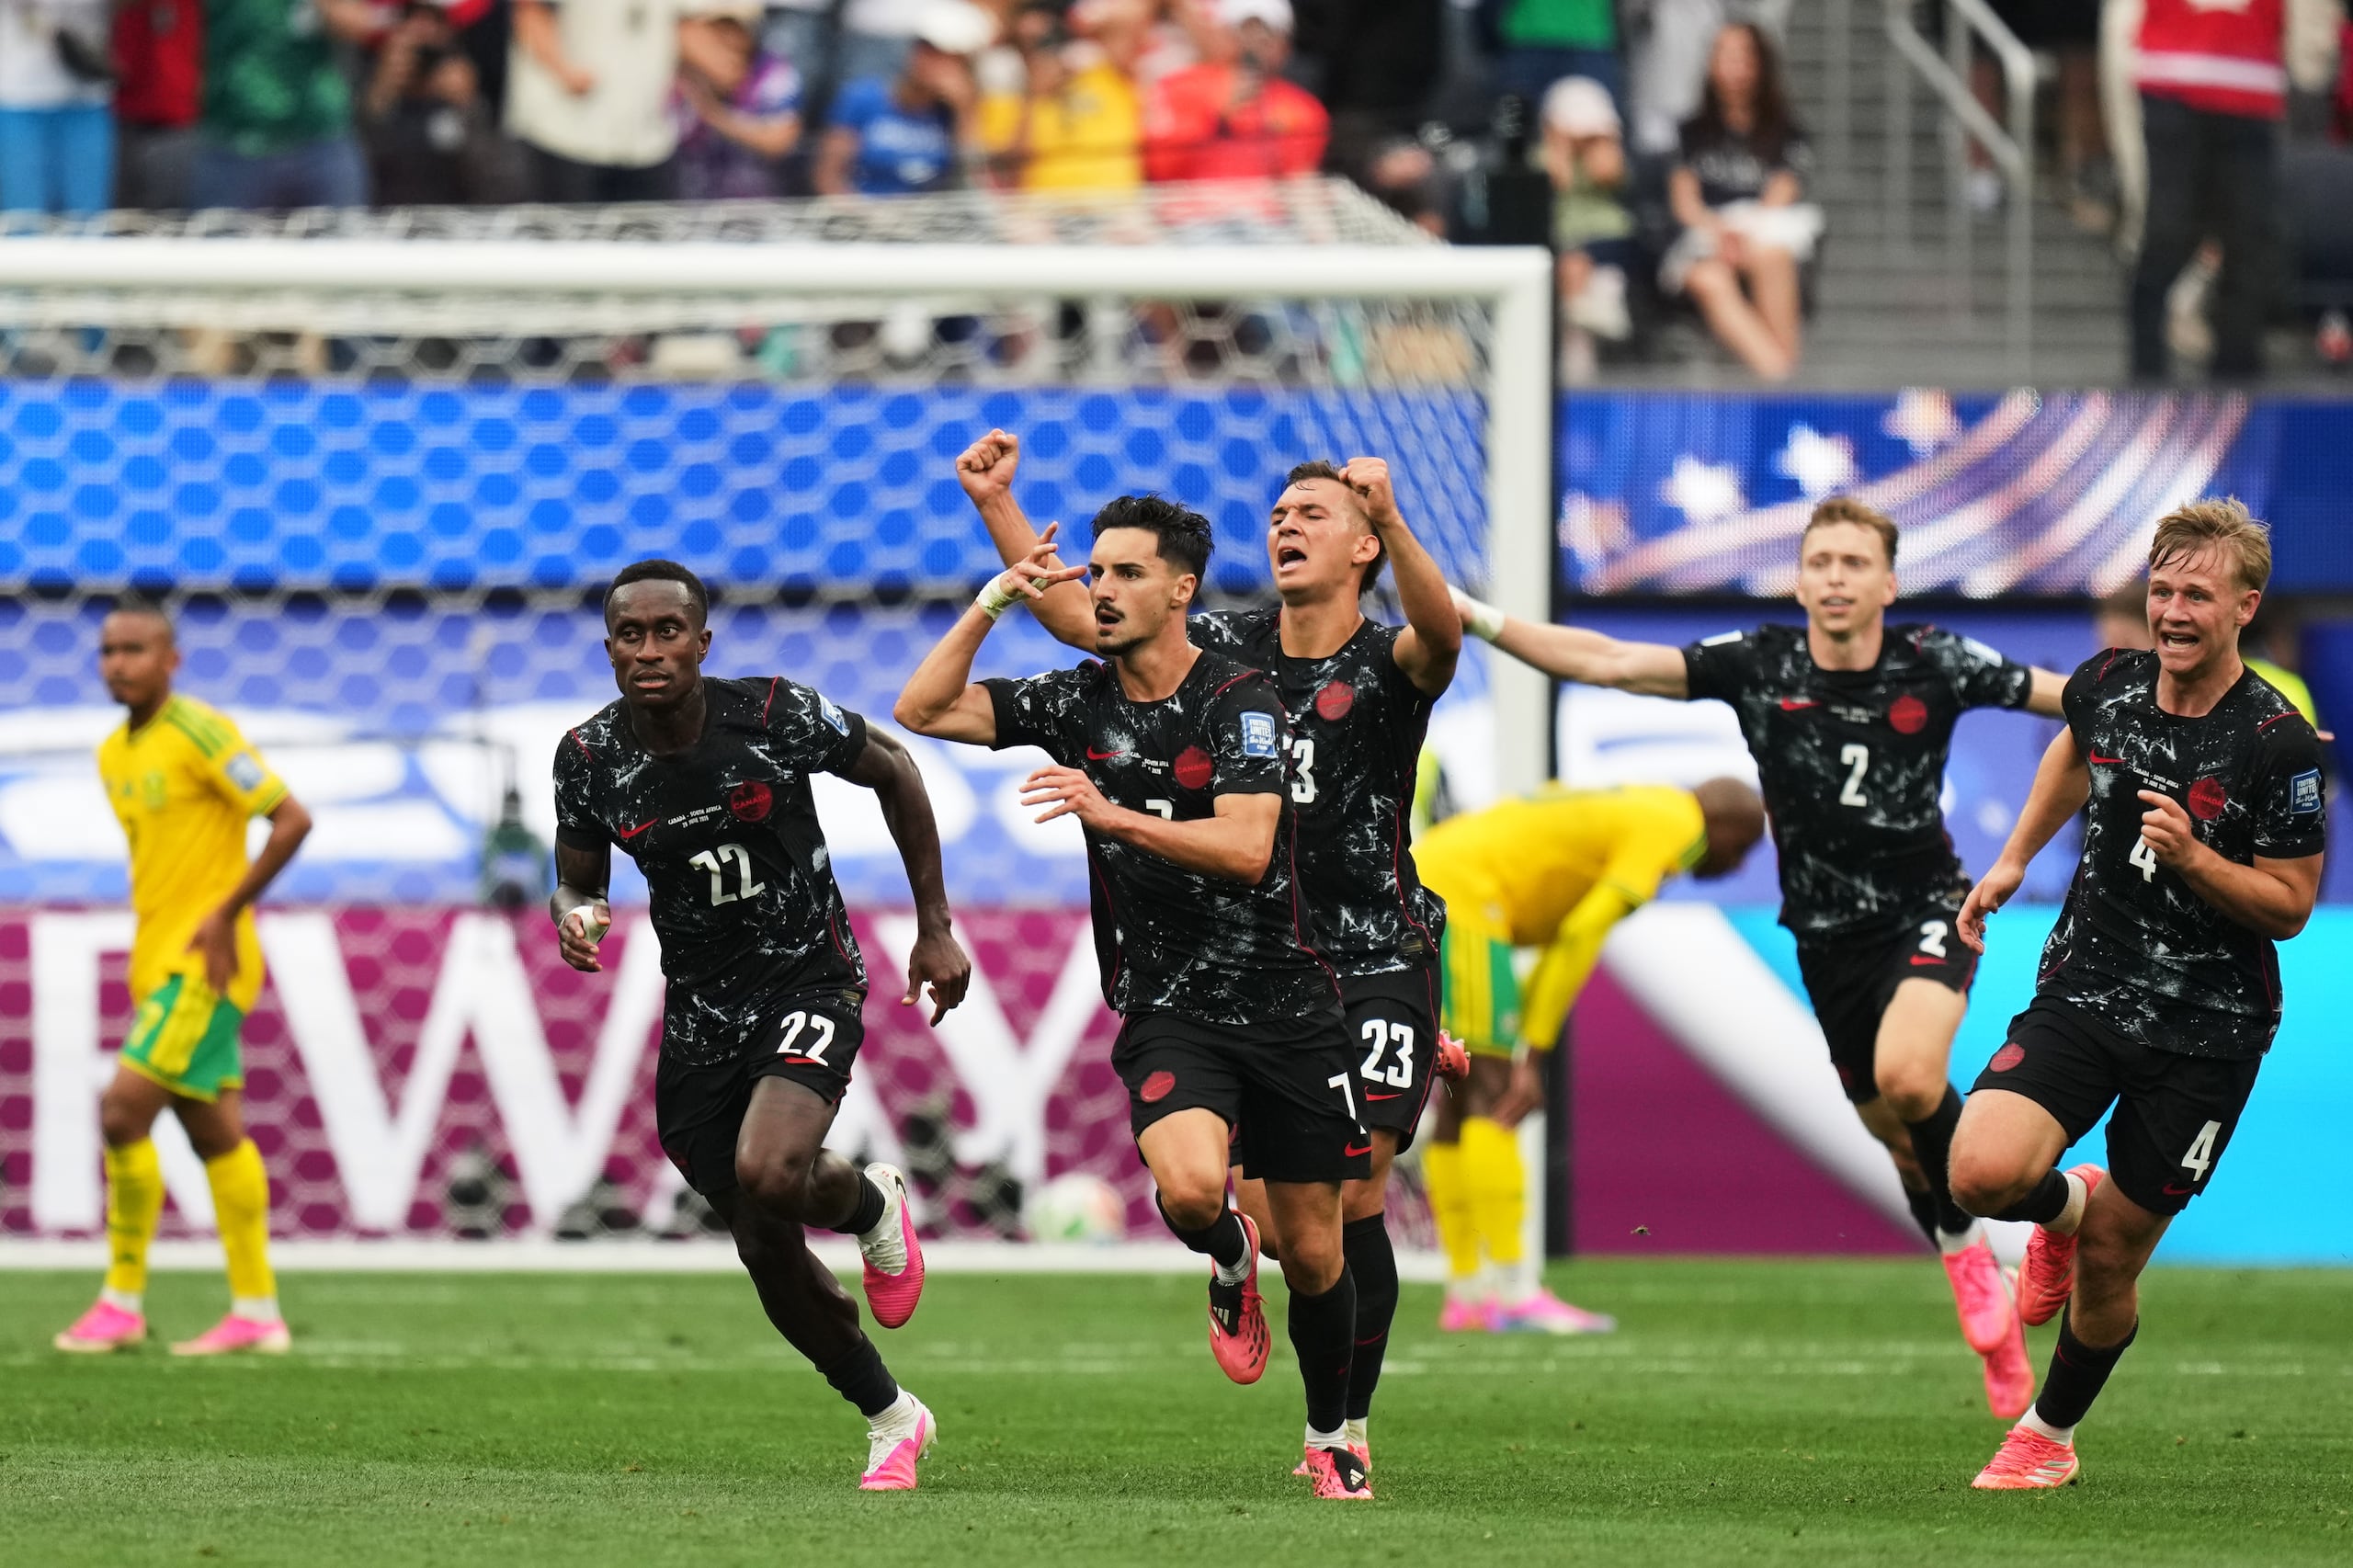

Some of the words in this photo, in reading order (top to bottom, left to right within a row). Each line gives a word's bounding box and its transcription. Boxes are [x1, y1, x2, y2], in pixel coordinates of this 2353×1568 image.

[1176, 763, 1211, 774] CANADA
[1839, 744, 1869, 807] 2
[733, 793, 771, 810] CANADA
[2189, 790, 2222, 807] CANADA
[688, 843, 766, 906] 22
[2129, 833, 2156, 882] 4
[1918, 920, 1949, 958] 2
[777, 1010, 835, 1067] 22
[1360, 1018, 1415, 1089] 23
[1327, 1072, 1368, 1134] 7
[2180, 1119, 2222, 1182] 4
